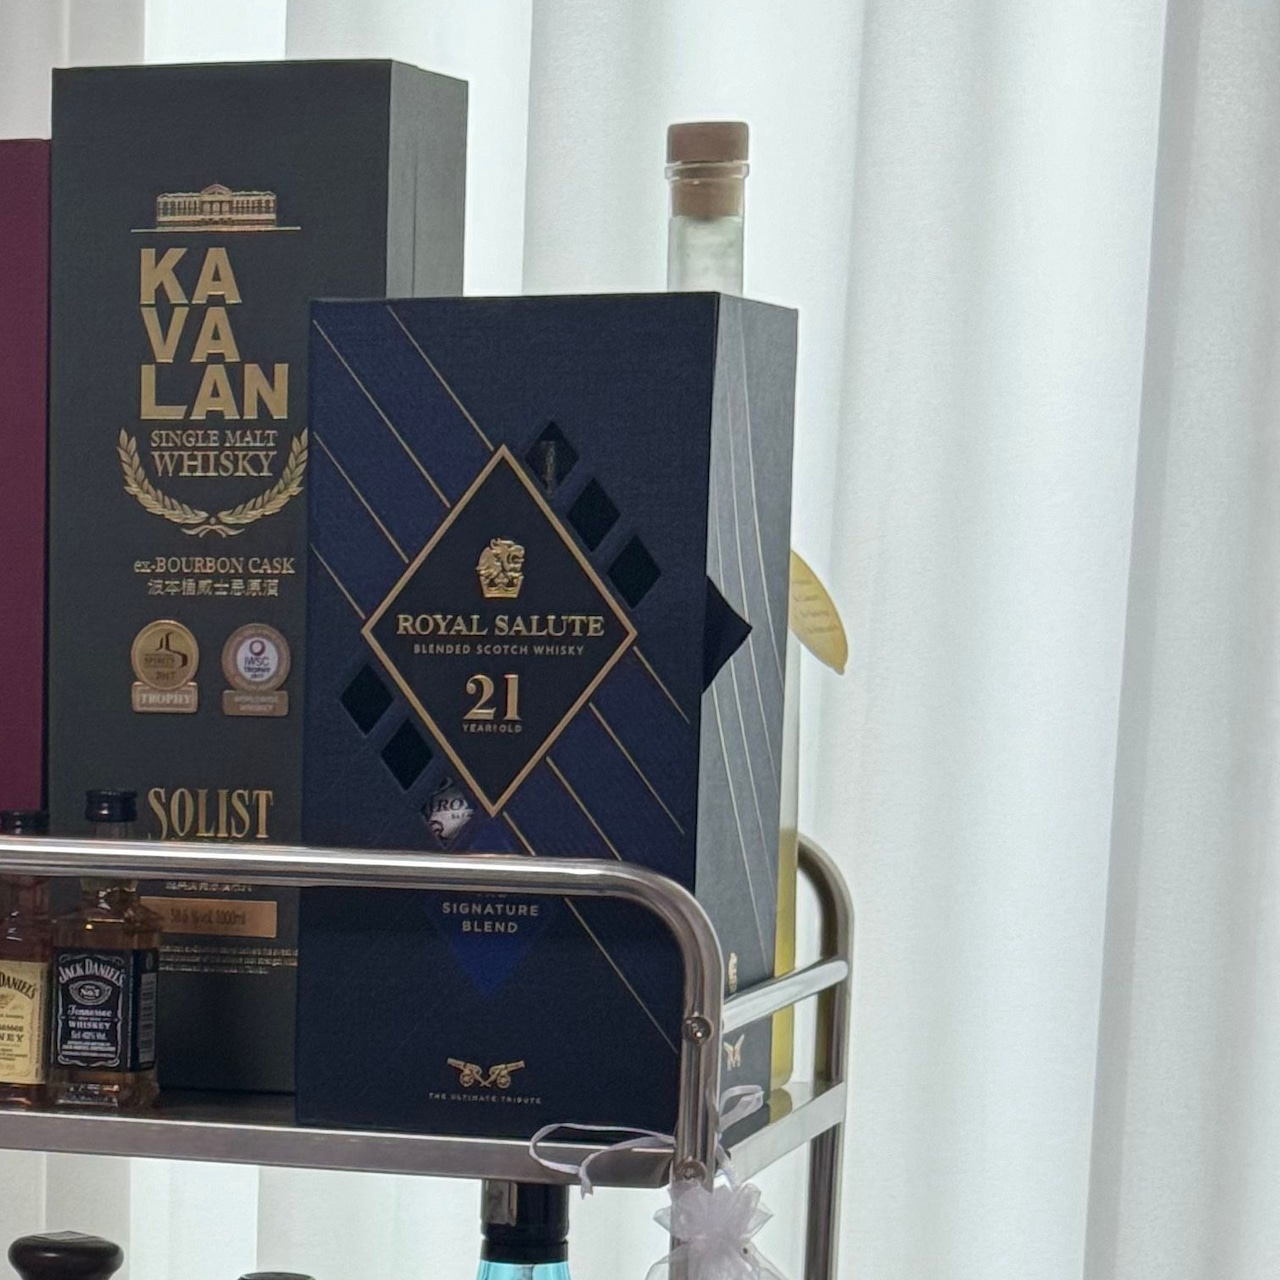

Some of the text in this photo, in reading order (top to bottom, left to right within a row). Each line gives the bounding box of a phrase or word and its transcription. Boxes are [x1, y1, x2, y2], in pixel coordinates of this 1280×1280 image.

[140, 247, 242, 304] KA
[140, 307, 241, 362] VA
[140, 363, 289, 420] LAN
[150, 430, 278, 448] SINGLE MALT
[151, 450, 278, 477] WHISKY
[133, 557, 296, 575] ex-BOURBON CASK
[396, 615, 605, 638] ROYAL SALUTE
[413, 644, 585, 656] BLENDED SCOTCH WHISKY
[462, 674, 522, 721] 21
[499, 724, 523, 734] OLD
[147, 787, 274, 840] SOLIST
[442, 902, 539, 917] SIGNATURE
[462, 920, 518, 934] BLEND
[59, 963, 84, 984] JACK
[68, 1020, 111, 1030] WHISKEY
[429, 1092, 541, 1105] THE ULTIMATE TRIBUTE
